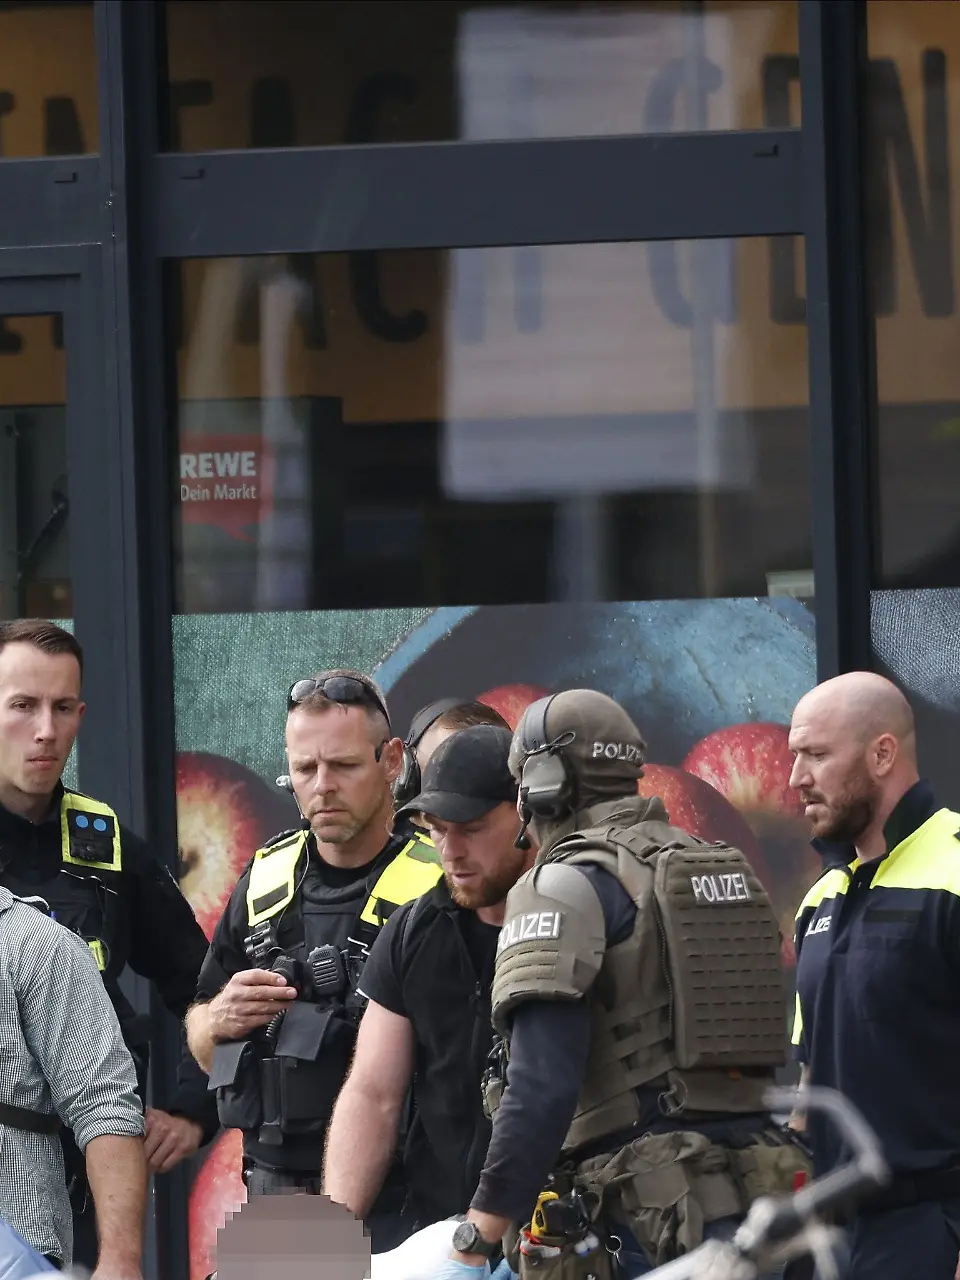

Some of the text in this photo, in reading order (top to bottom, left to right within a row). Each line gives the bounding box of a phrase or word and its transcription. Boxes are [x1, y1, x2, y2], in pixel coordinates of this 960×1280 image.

[179, 451, 257, 479] REWE
[180, 484, 257, 501] Dein Markt
[691, 873, 752, 902] POLIZEI
[497, 911, 560, 950] OLIZEI
